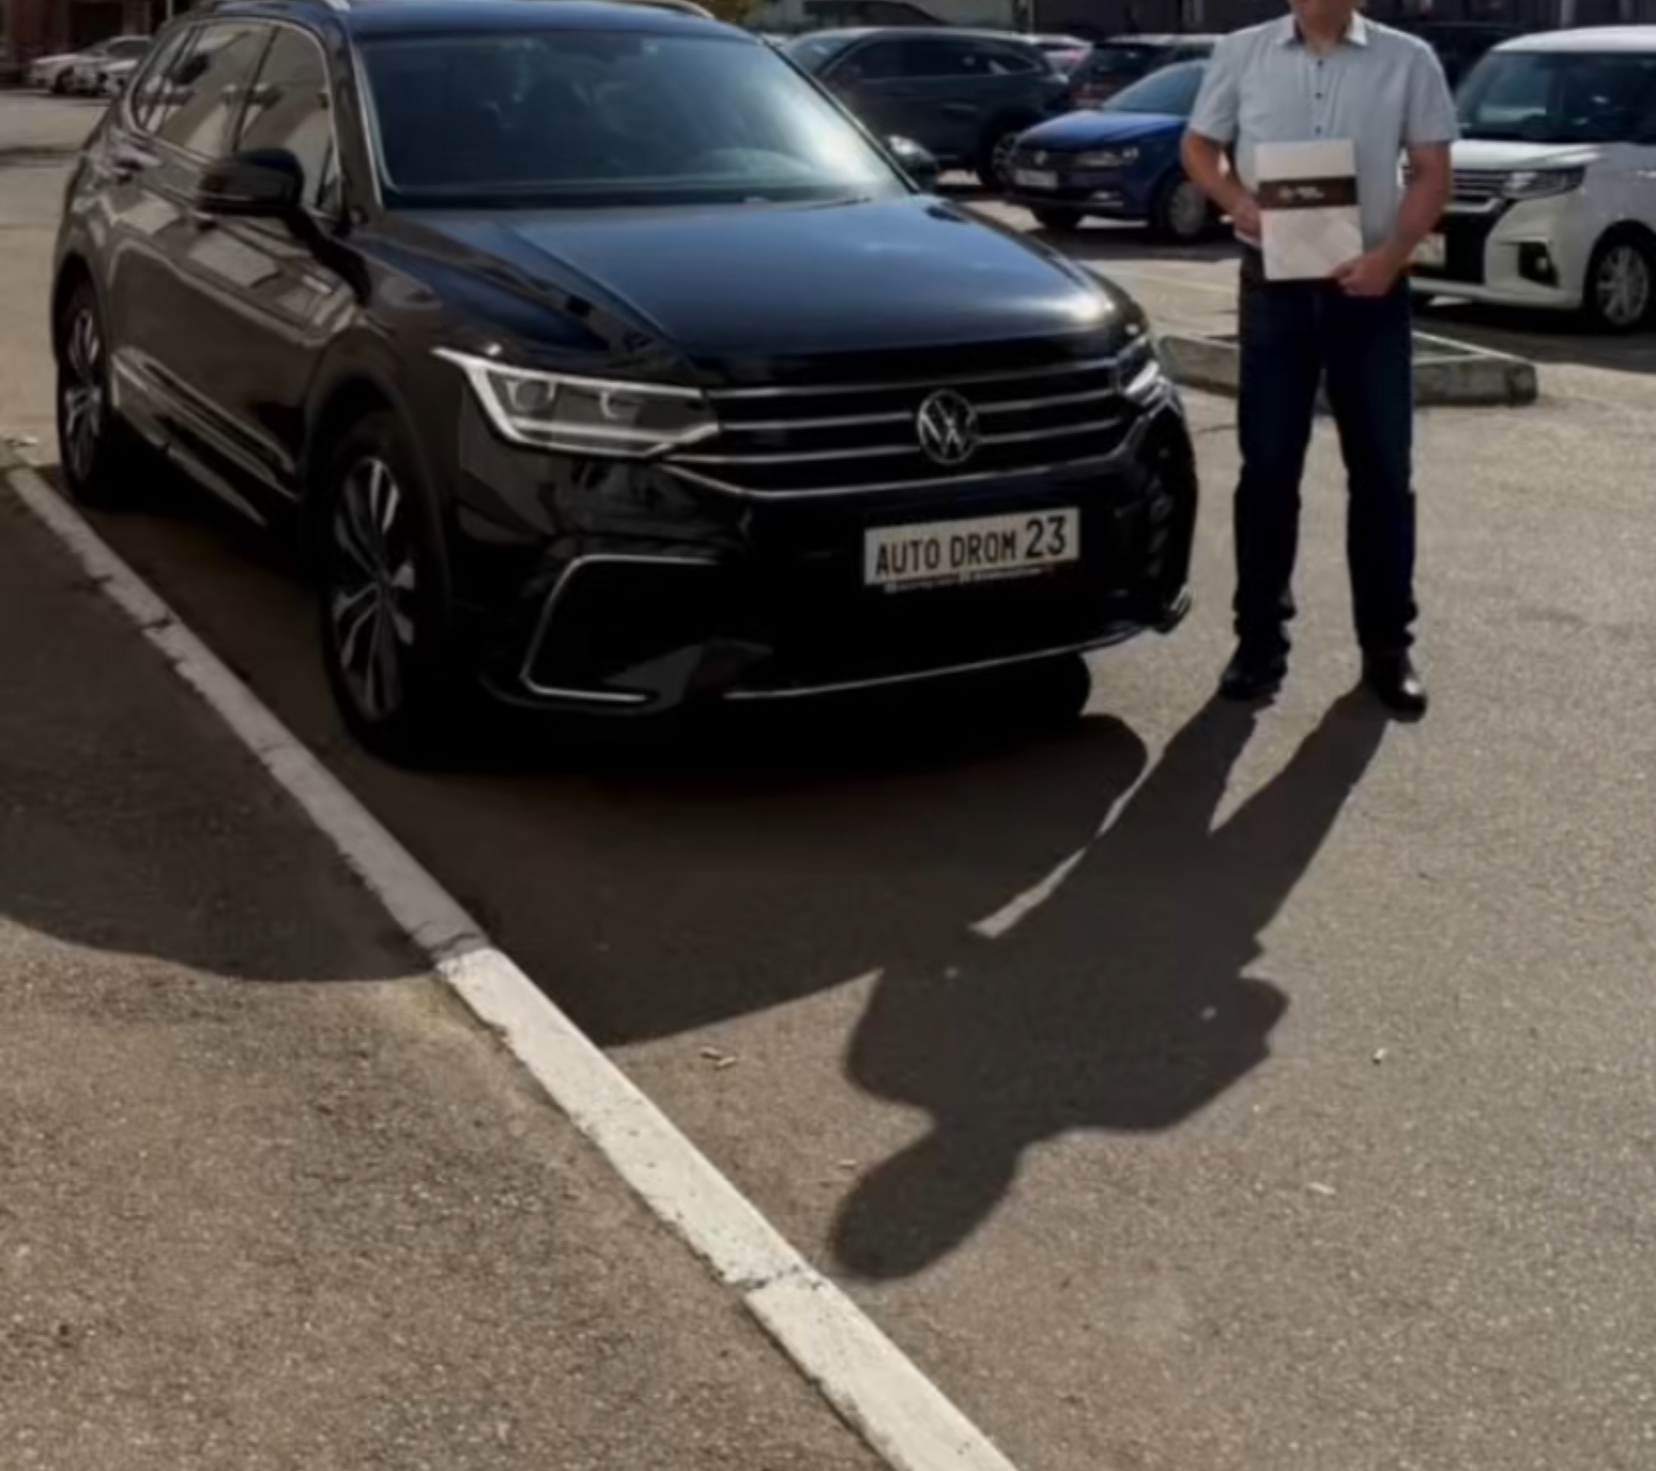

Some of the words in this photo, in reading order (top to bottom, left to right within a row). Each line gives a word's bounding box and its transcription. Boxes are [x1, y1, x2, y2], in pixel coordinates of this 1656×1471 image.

[876, 538, 940, 575] AUTO
[950, 530, 1016, 567] DROM
[1025, 515, 1066, 559] 23
